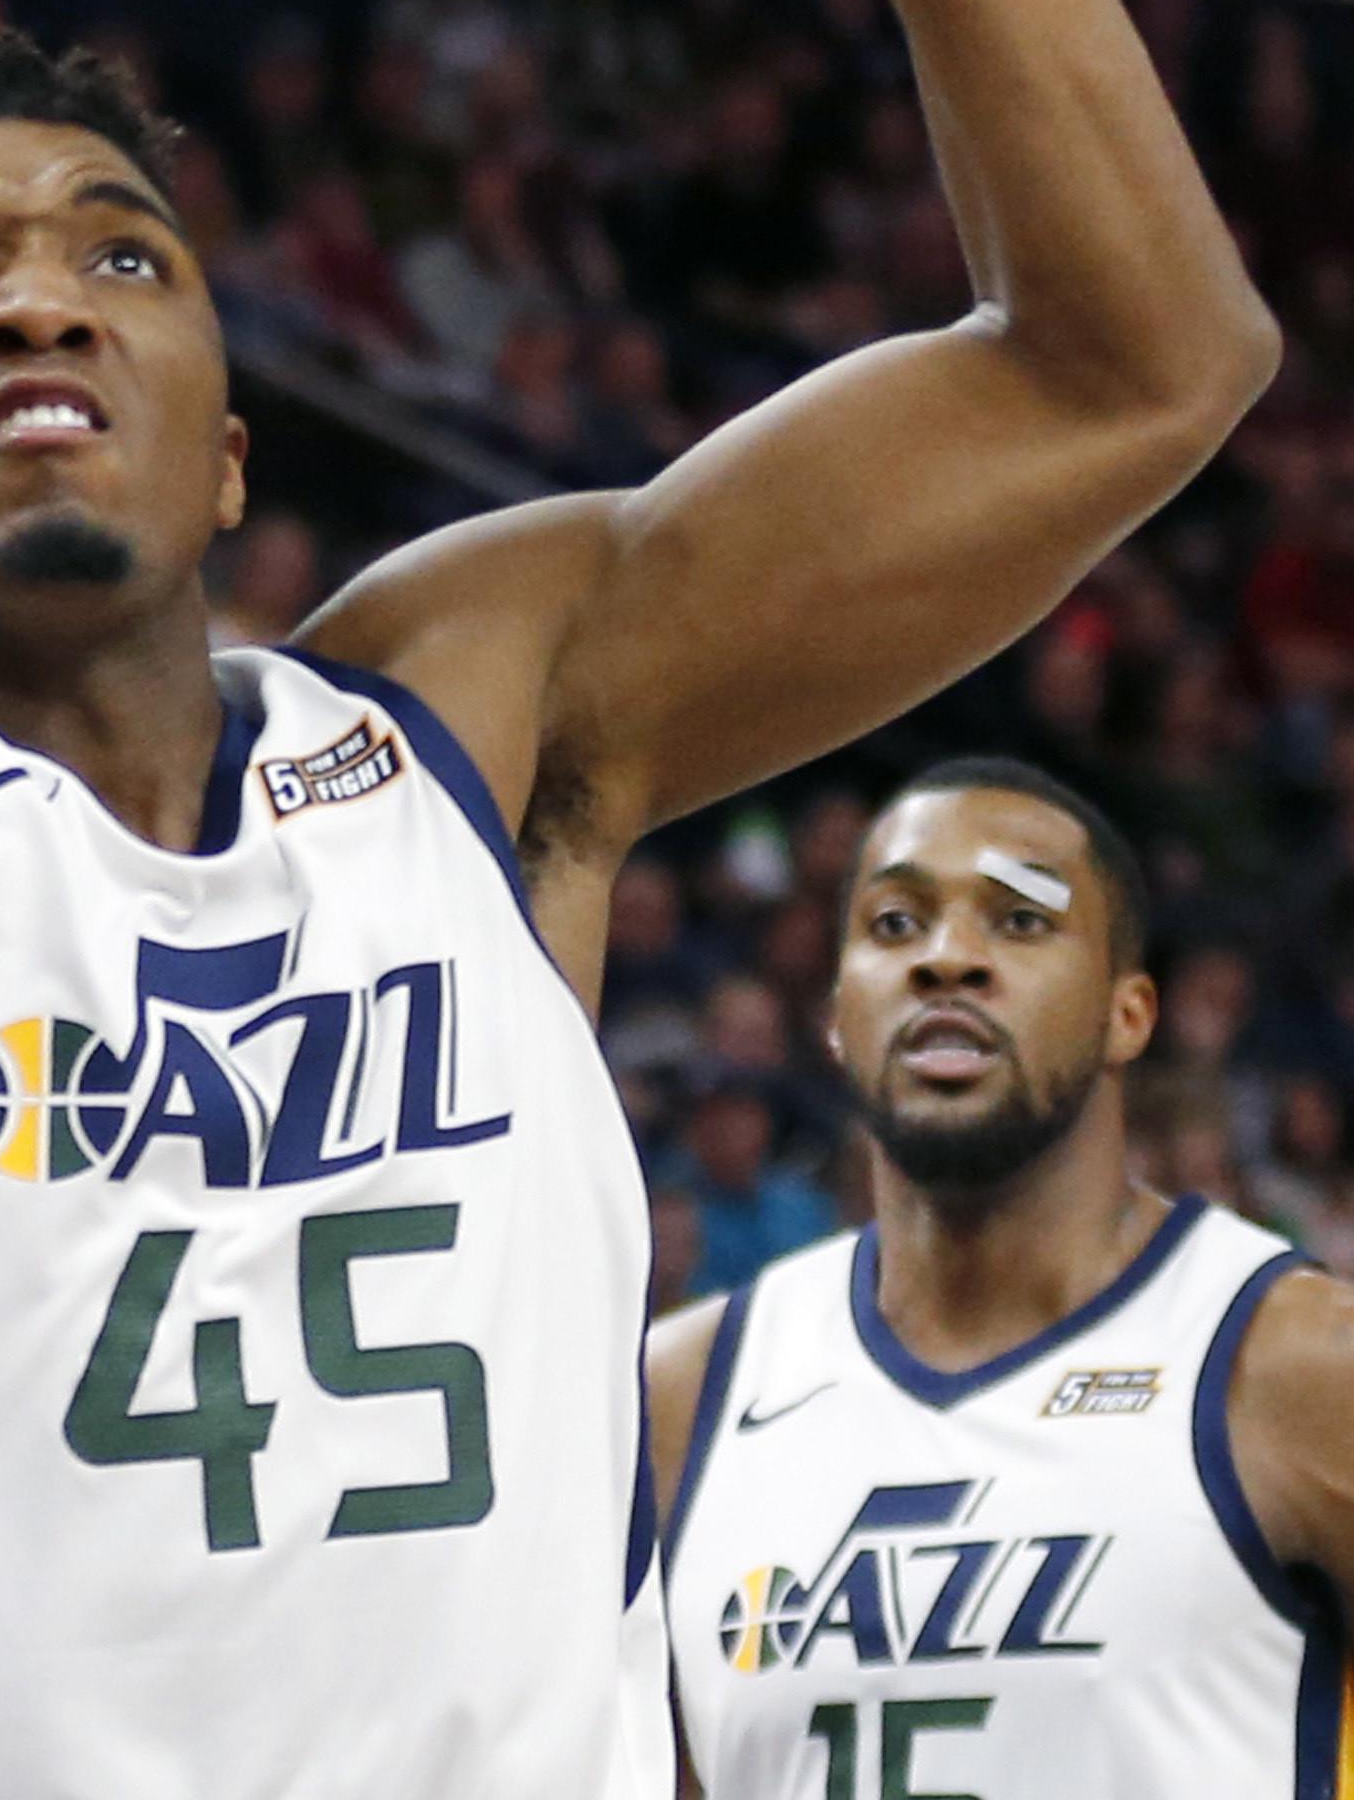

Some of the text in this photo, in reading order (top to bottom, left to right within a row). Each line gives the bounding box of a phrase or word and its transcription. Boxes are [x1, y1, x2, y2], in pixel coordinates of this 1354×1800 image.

[263, 760, 308, 812] 5
[314, 744, 394, 802] FIGHT
[62, 1202, 496, 1554] 45
[718, 1476, 1117, 1674] JAZZ
